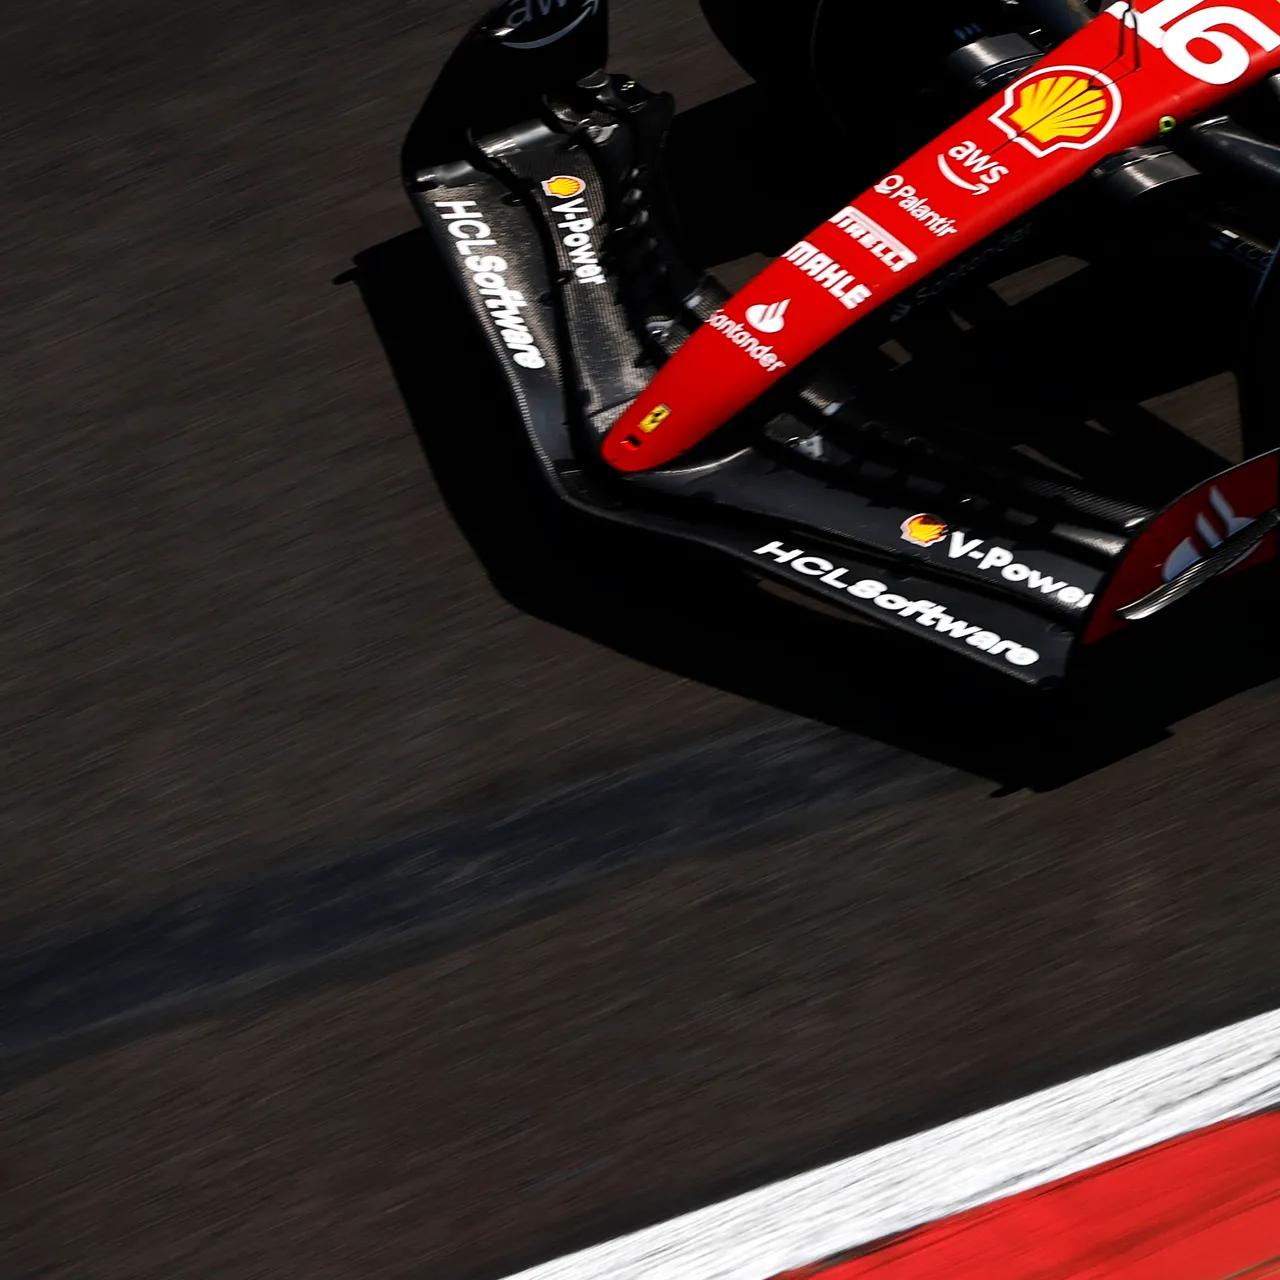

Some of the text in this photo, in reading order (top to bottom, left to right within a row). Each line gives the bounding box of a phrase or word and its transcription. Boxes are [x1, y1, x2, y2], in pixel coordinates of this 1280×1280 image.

[948, 140, 1009, 185] aws
[551, 197, 607, 286] V-Power
[828, 205, 918, 273] PIRELLI
[889, 184, 958, 238] Palantir
[434, 200, 547, 370] HCLSoftware
[780, 240, 873, 310] MAHLE
[752, 540, 1040, 667] HCLSoftware
